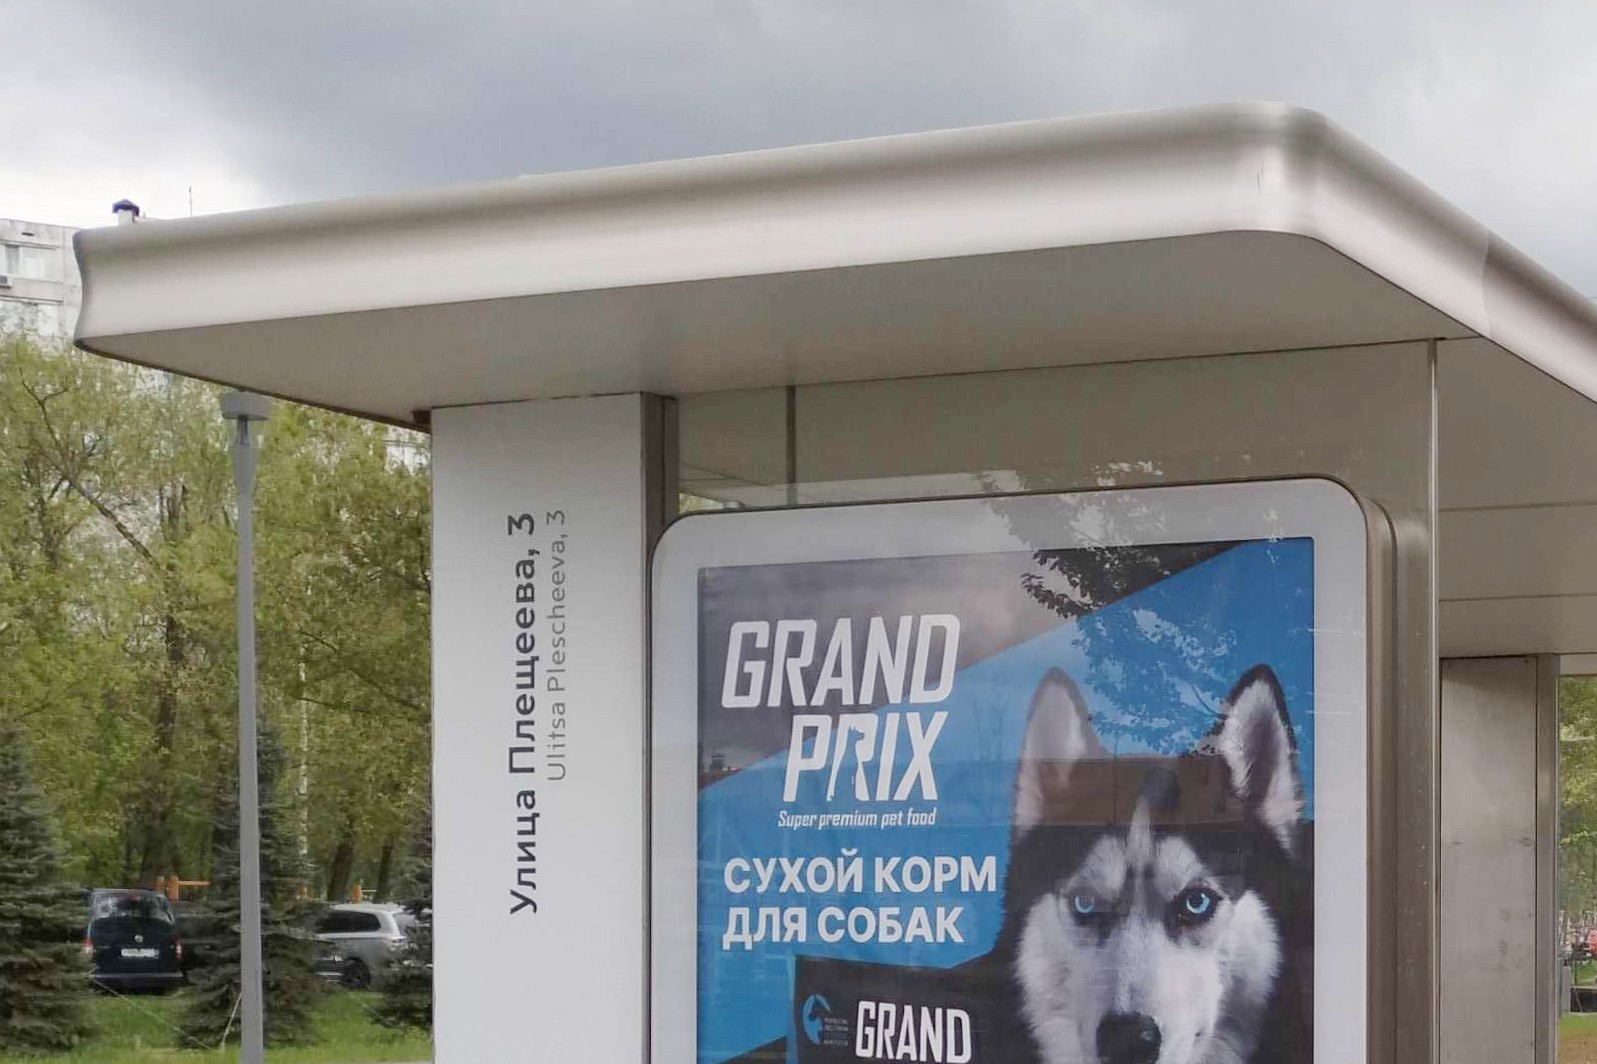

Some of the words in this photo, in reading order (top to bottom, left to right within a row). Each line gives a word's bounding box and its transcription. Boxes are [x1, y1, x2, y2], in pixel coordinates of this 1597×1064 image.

[507, 512, 535, 536] 3
[545, 509, 566, 526] 3
[546, 533, 568, 692] Plescheeva,
[508, 549, 540, 774] Плещеева,
[721, 614, 961, 708] GRAND
[547, 701, 567, 781] Ulitsa
[782, 711, 949, 802] PRIX
[509, 789, 540, 915] Улица
[777, 810, 817, 830] Super
[818, 809, 878, 830] premium
[881, 809, 903, 829] pet
[907, 807, 937, 826] food
[723, 848, 864, 893] СУХОЙ
[874, 855, 997, 893] КОРМ
[722, 906, 807, 950] ДЛЯ
[817, 906, 964, 943] СОБАК
[855, 1000, 973, 1064] GRAND
